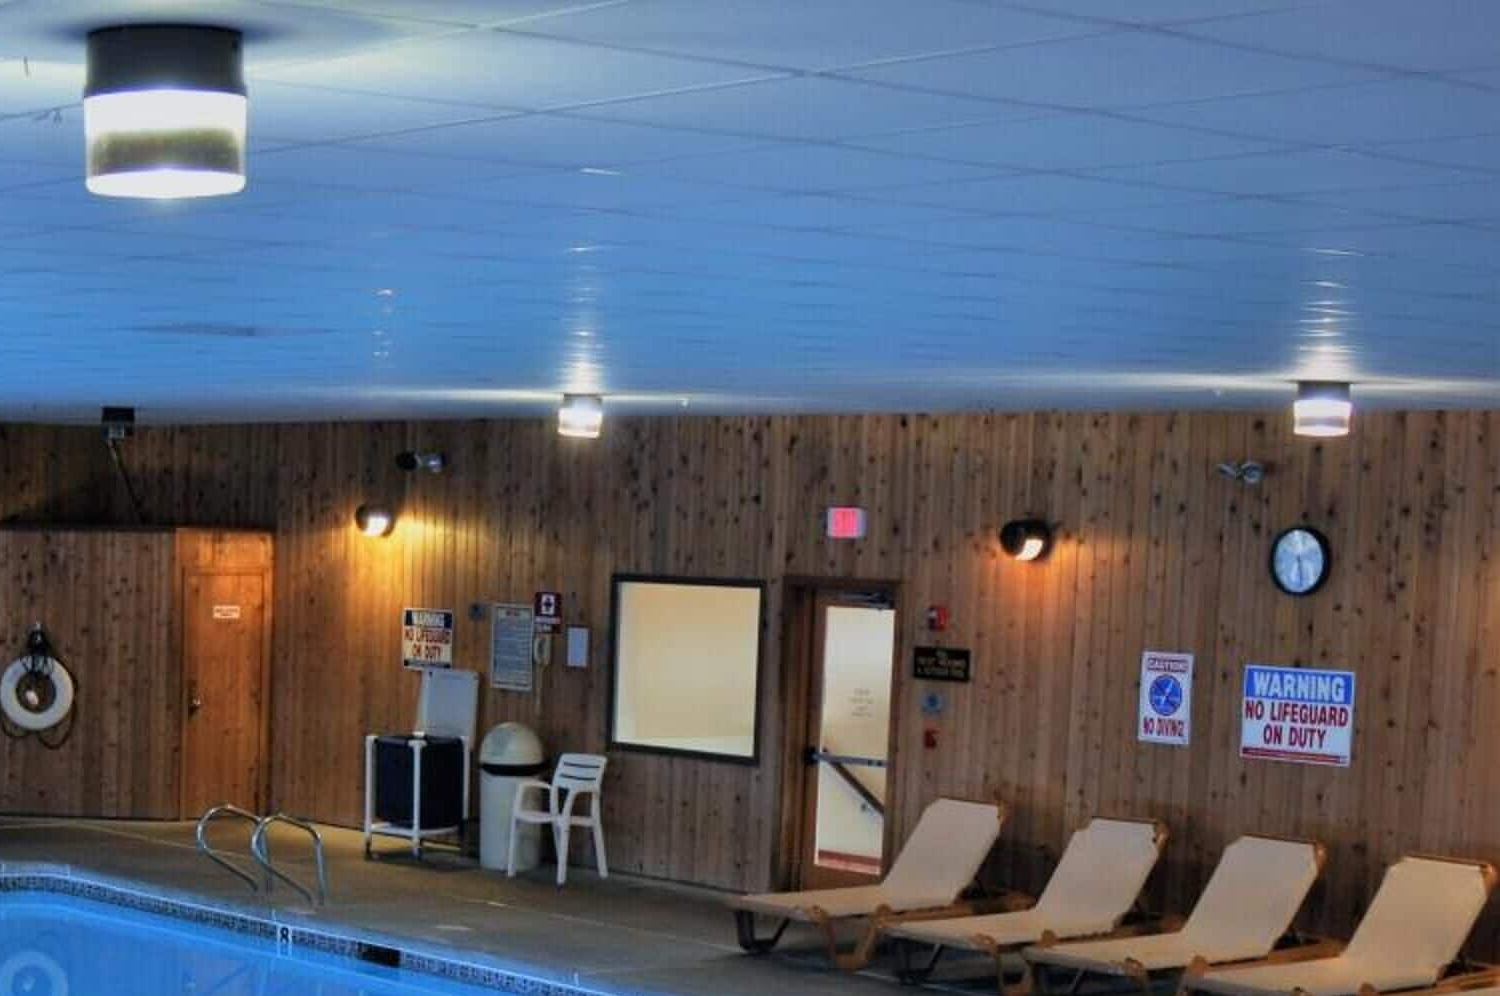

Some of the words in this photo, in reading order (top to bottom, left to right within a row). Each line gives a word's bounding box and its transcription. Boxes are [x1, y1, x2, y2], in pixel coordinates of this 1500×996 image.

[1252, 671, 1345, 703] WARNING
[1143, 716, 1155, 735] NO
[1245, 699, 1265, 720] NO
[1270, 701, 1349, 728] LIFEGUARD
[1263, 723, 1283, 745] ON
[1288, 726, 1327, 750] DUTY
